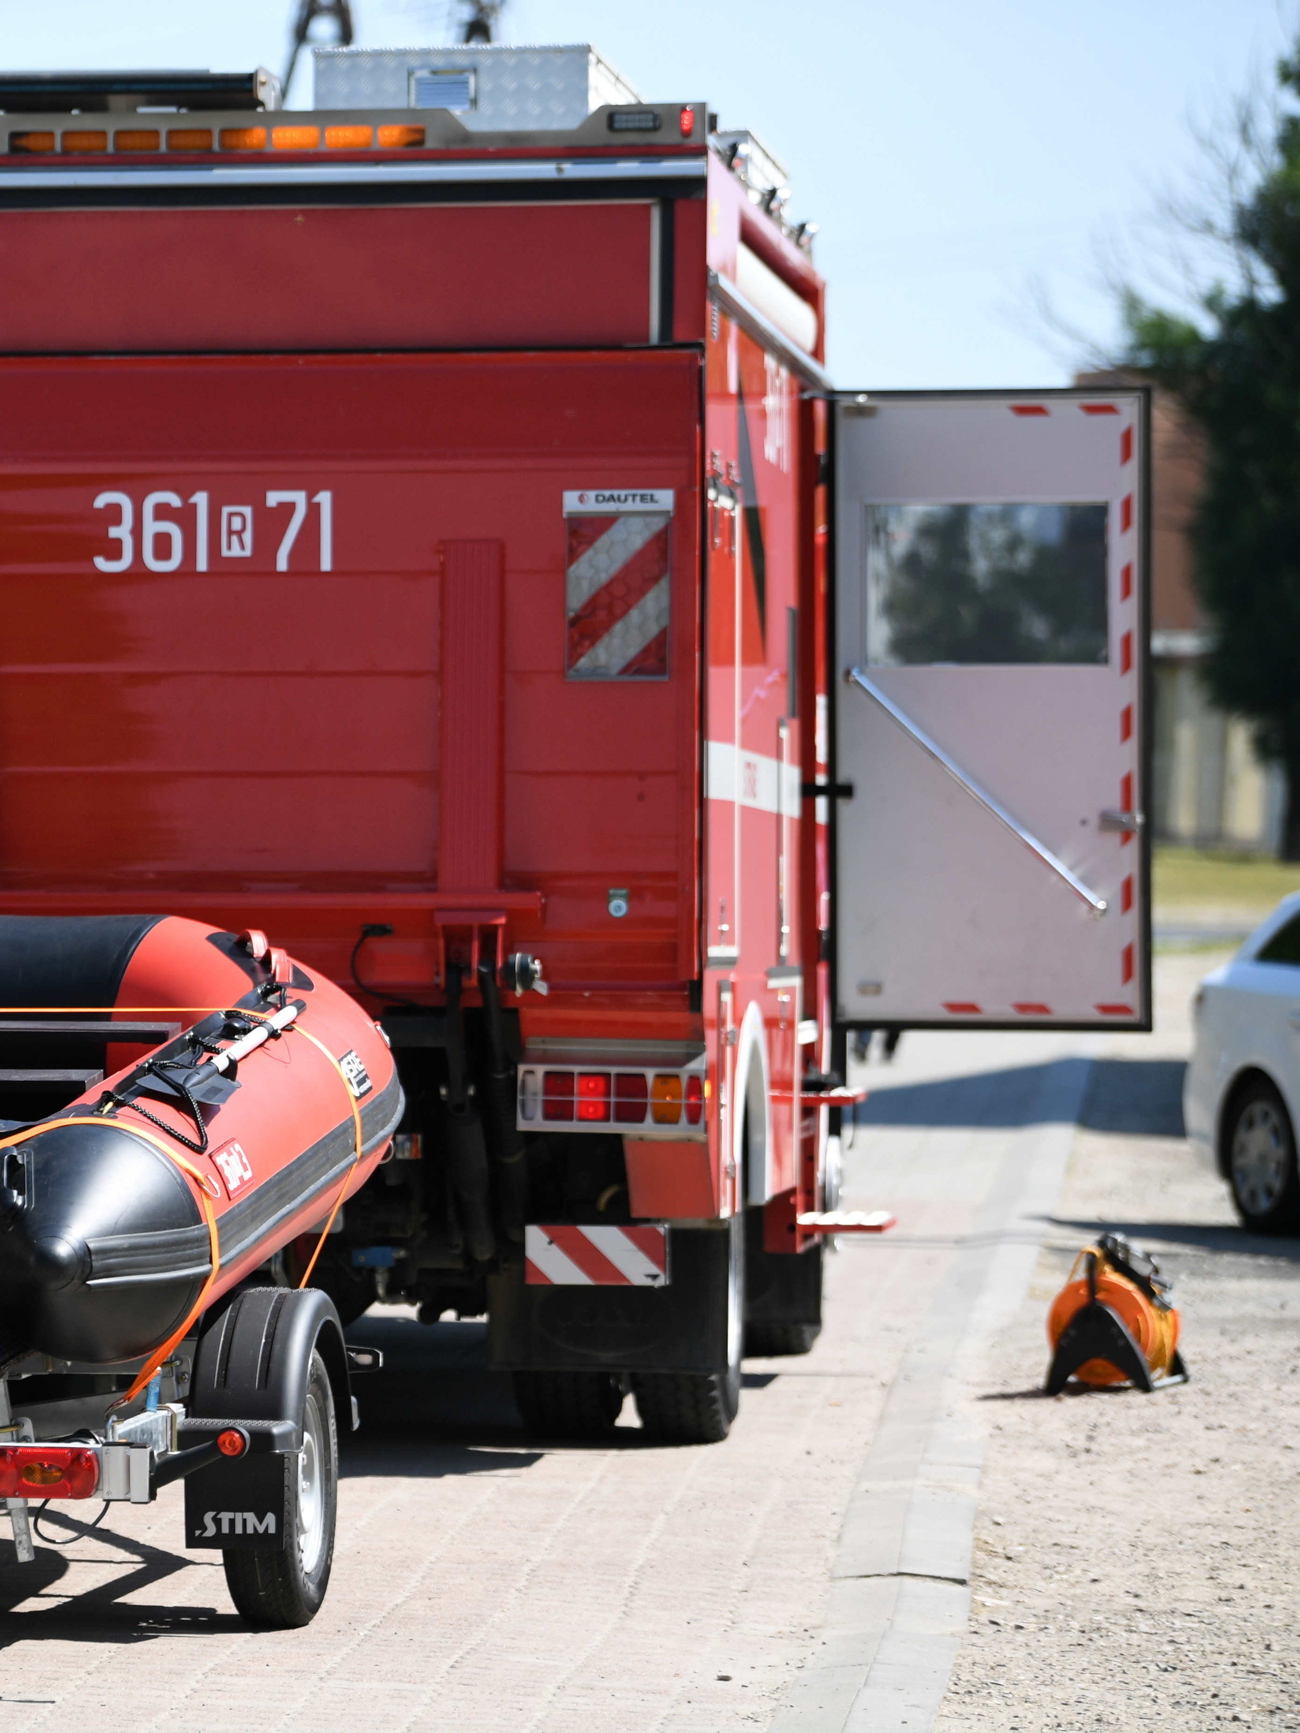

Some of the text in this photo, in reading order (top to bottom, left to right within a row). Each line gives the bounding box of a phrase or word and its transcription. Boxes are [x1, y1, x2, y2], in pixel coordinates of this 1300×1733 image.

[594, 493, 659, 504] DAUTEL
[93, 490, 209, 573] 361
[265, 490, 332, 573] 71
[194, 1511, 276, 1537] STIM
